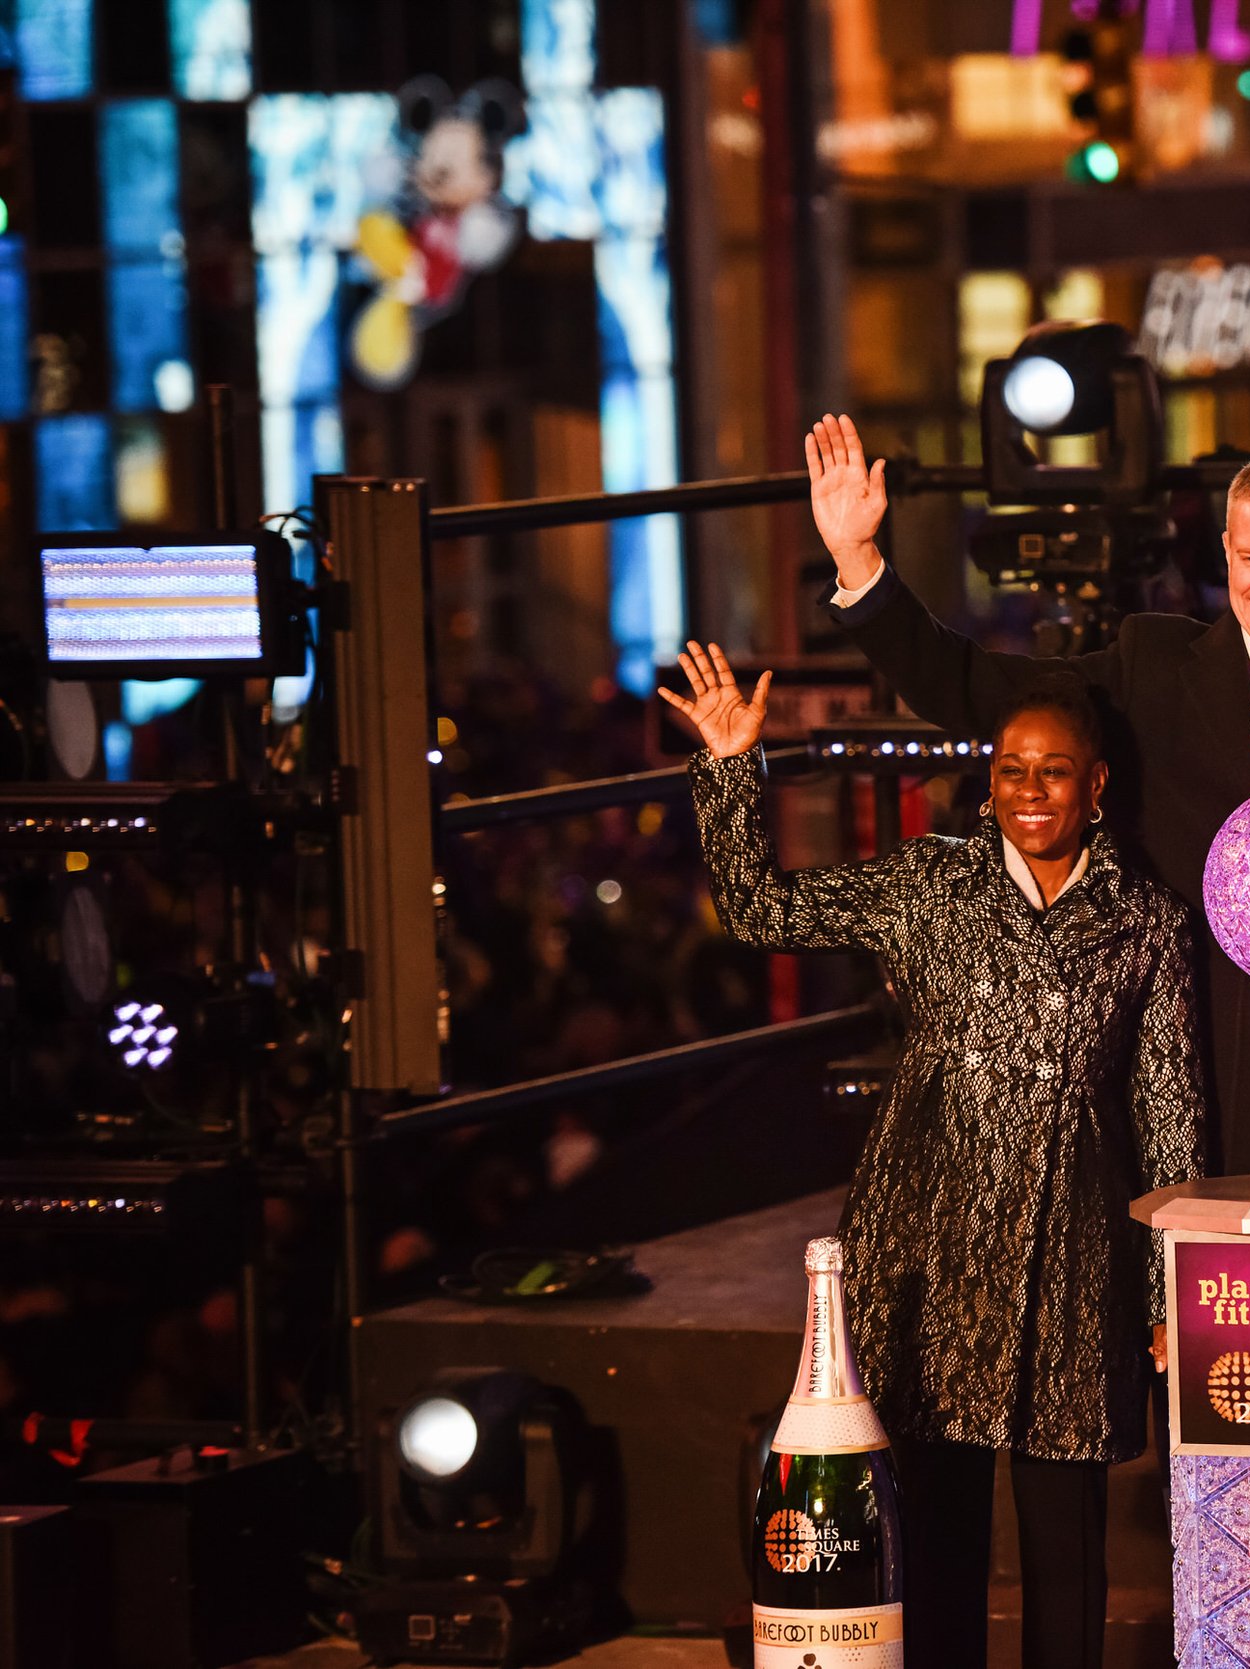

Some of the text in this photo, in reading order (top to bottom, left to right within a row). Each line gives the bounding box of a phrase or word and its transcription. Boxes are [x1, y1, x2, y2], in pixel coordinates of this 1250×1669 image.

[808, 1294, 827, 1393] BAREFOOT BUBBLY
[796, 1528, 840, 1540] TIMES
[804, 1540, 860, 1554] SQUARE
[820, 1621, 879, 1642] BUBBLY
